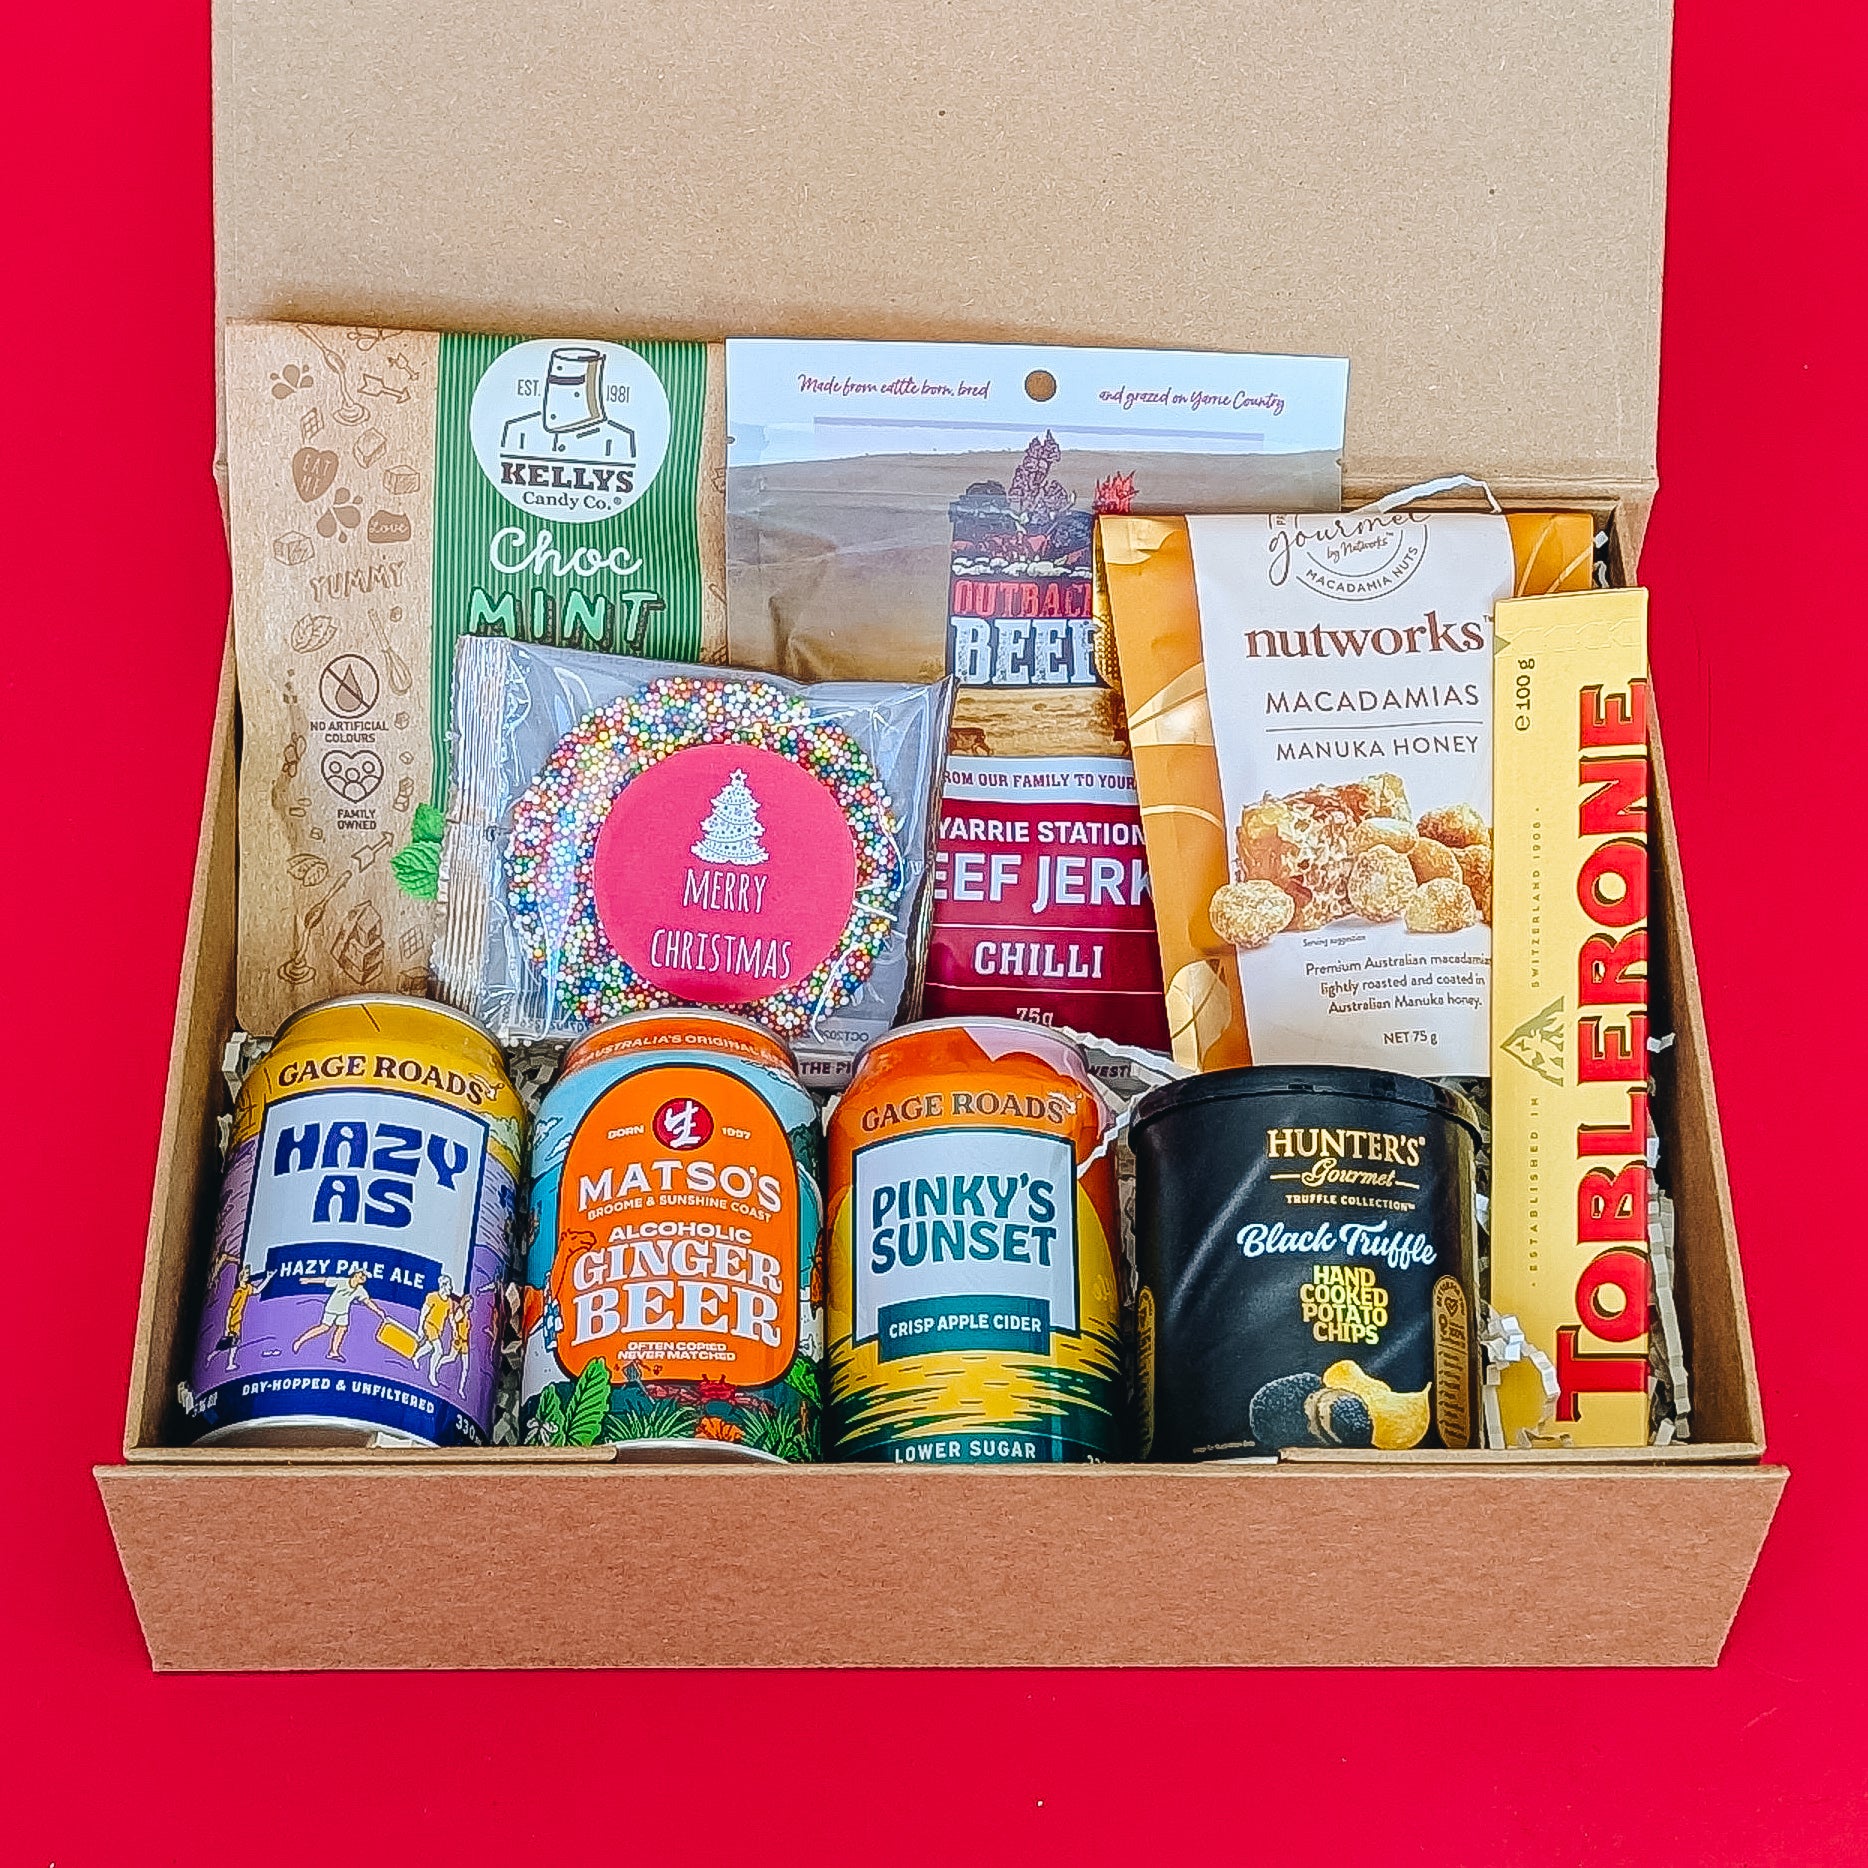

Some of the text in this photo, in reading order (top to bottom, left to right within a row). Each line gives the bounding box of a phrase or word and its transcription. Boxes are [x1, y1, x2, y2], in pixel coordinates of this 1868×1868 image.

[518, 379, 541, 396] EST.
[606, 385, 630, 403] 1981
[798, 374, 842, 393] Made
[842, 376, 876, 396] from
[881, 376, 920, 394] cattle
[958, 380, 991, 399] bred
[1100, 385, 1126, 404] and
[1124, 387, 1172, 410] grazed
[1172, 393, 1188, 404] on
[1233, 390, 1284, 416] Country
[303, 454, 331, 476] EAT
[500, 462, 634, 494] KELLYS
[522, 492, 579, 510] Candy
[369, 520, 408, 534] Love
[490, 526, 642, 578] Choc
[309, 561, 406, 602] YUMMY
[1306, 546, 1418, 592] MACADAMIA NUTS
[468, 587, 665, 647] MINT
[1265, 684, 1480, 714] MACADAMIAS
[310, 722, 389, 731] NO ARTIFICIAL
[325, 734, 376, 743] COLOURS
[1276, 736, 1478, 761] MANUKA HONEY
[979, 773, 1008, 787] OUR
[1014, 774, 1069, 788] FAMILY
[1074, 774, 1094, 786] TO
[1098, 774, 1136, 790] YOUR
[338, 809, 376, 818] FAMILY
[338, 820, 376, 830] OWNED
[938, 817, 1146, 846] YARRIE STATION
[683, 868, 768, 914] MERRY
[1531, 869, 1542, 988] SWITZERLAND
[650, 928, 792, 980] CHRISTMAS
[974, 941, 1104, 978] CHILLI
[1306, 960, 1361, 976] Premium
[1364, 953, 1427, 970] Australian
[1320, 972, 1486, 997] lightly roasted and coated in
[1328, 992, 1482, 1014] Australian Manuka honey.
[685, 1034, 756, 1056] ORIGINAL
[1384, 1030, 1438, 1046] NET 75 g
[1556, 678, 1649, 1422] TOBLERONE
[278, 1056, 484, 1106] GAGE ROADS
[800, 1062, 830, 1074] THE
[861, 1092, 1064, 1132] GAGE ROADS
[607, 1125, 644, 1140] BORN
[273, 1121, 470, 1192] HAZY
[1300, 1157, 1396, 1188] Gourmet
[1530, 1097, 1539, 1272] ESTABLISHED IN
[578, 1159, 782, 1213] MATSO'S
[312, 1174, 414, 1229] AS
[588, 1194, 772, 1223] BROOME & SUNSHINE COAST
[872, 1172, 1056, 1230] PINKY'S
[1286, 1194, 1338, 1205] TRUFFLE
[608, 1222, 752, 1244] ALCOHOLIC
[1236, 1220, 1438, 1270] Black Truffle
[870, 1220, 1056, 1275] SUNSET
[280, 1259, 424, 1289] HAZY PALE ALE
[572, 1238, 783, 1295] GINGER
[1313, 1264, 1376, 1289] HAND
[1300, 1284, 1389, 1308] COOKED
[571, 1280, 782, 1348] BEER
[889, 1313, 1042, 1339] CRISP APPLE CIDER
[1301, 1303, 1388, 1328] POTATO
[627, 1342, 727, 1352] OFTEN COPIED
[1312, 1322, 1380, 1346] CHIPS
[617, 1350, 736, 1361] NEVER MATCHED
[242, 1377, 434, 1414] DRY-HOPPED & UNFILTERED
[895, 1440, 1036, 1464] LOWER SUGAR
